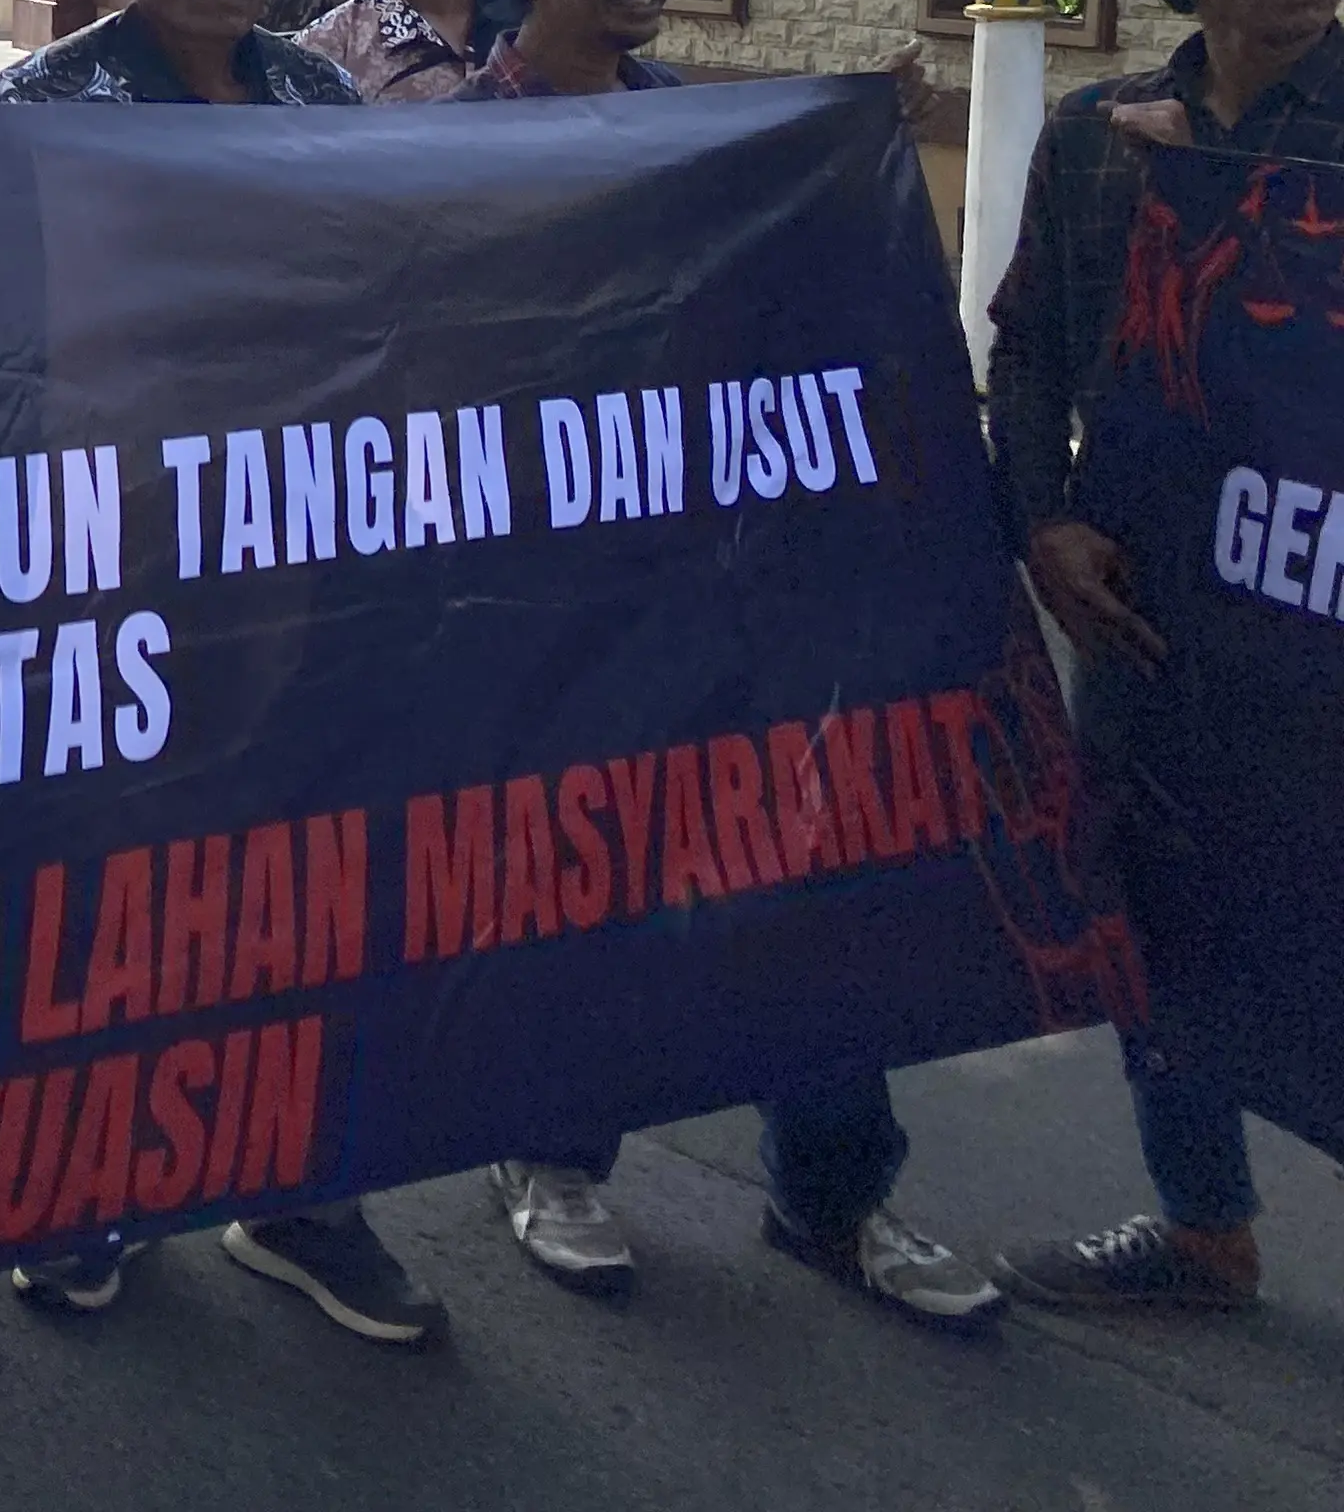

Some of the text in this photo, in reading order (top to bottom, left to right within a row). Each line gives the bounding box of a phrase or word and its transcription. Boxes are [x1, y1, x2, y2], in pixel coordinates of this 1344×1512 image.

[162, 405, 511, 580] TANGAN
[539, 386, 684, 529] DAN
[708, 367, 880, 506] USUT
[20, 809, 368, 1042] LAHAN
[404, 688, 984, 961] MASYARAKAT
